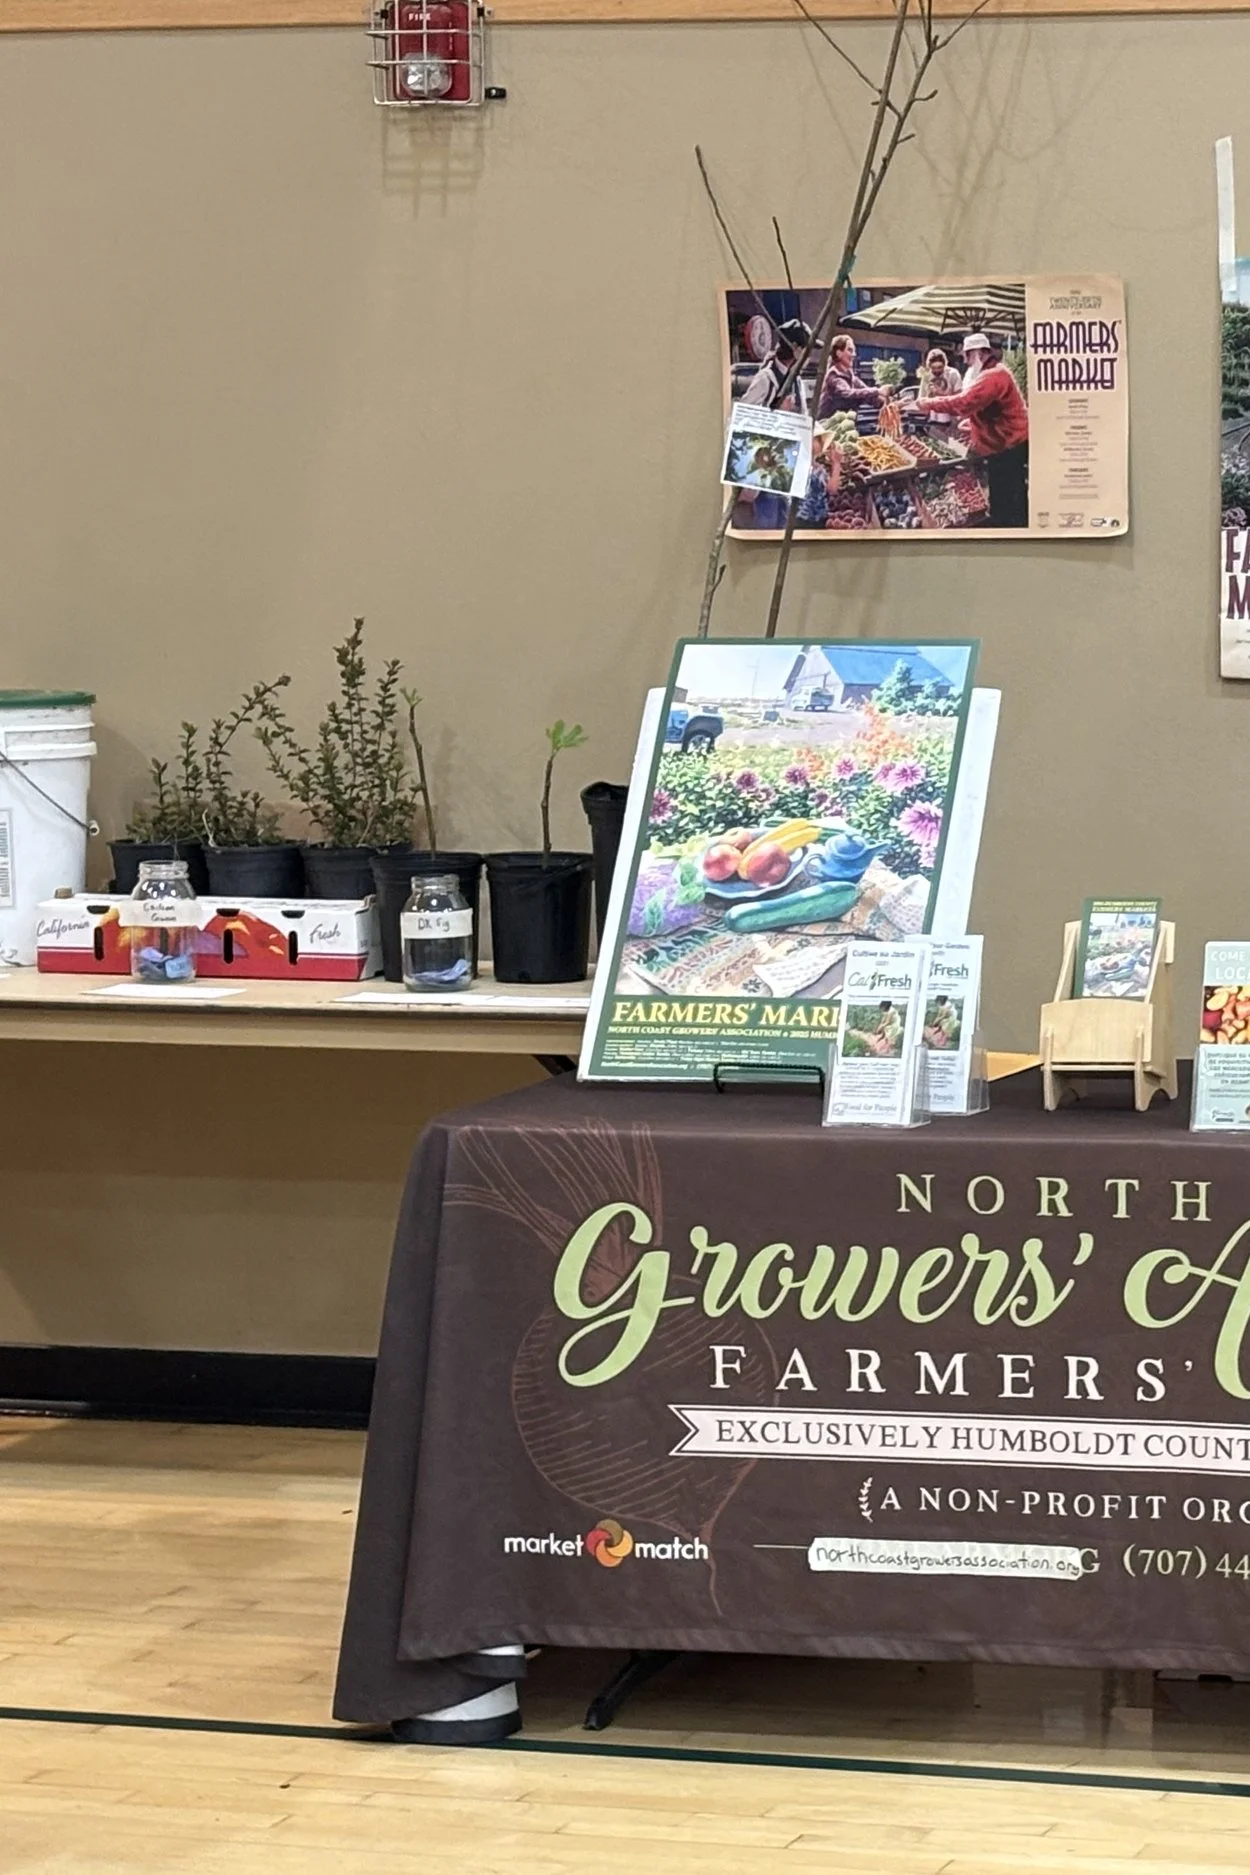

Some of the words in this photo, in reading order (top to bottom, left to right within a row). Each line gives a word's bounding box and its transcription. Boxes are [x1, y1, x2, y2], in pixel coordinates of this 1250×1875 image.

[1037, 358, 1117, 391] MARKET
[37, 919, 90, 939] California
[310, 923, 341, 944] Fresh
[934, 963, 969, 976] Fresh
[1211, 951, 1246, 961] COME
[878, 974, 912, 987] Fresh
[612, 1002, 756, 1024] FARMERS'
[720, 1028, 782, 1037] ASSOCIATION
[896, 1173, 1212, 1222] NORTH
[554, 1201, 1094, 1387] Growers'
[708, 1345, 1194, 1403] FARMERS'
[716, 1418, 943, 1450] EXCLUSIVELY
[951, 1428, 1135, 1456] HUMBOLDT
[880, 1487, 901, 1510] A
[919, 1487, 1167, 1519] NON-PROFIT
[504, 1533, 584, 1556] market
[635, 1537, 709, 1560] match
[816, 1545, 1080, 1576] northcoastgrowersassociation.org
[1122, 1546, 1208, 1579] (707)
